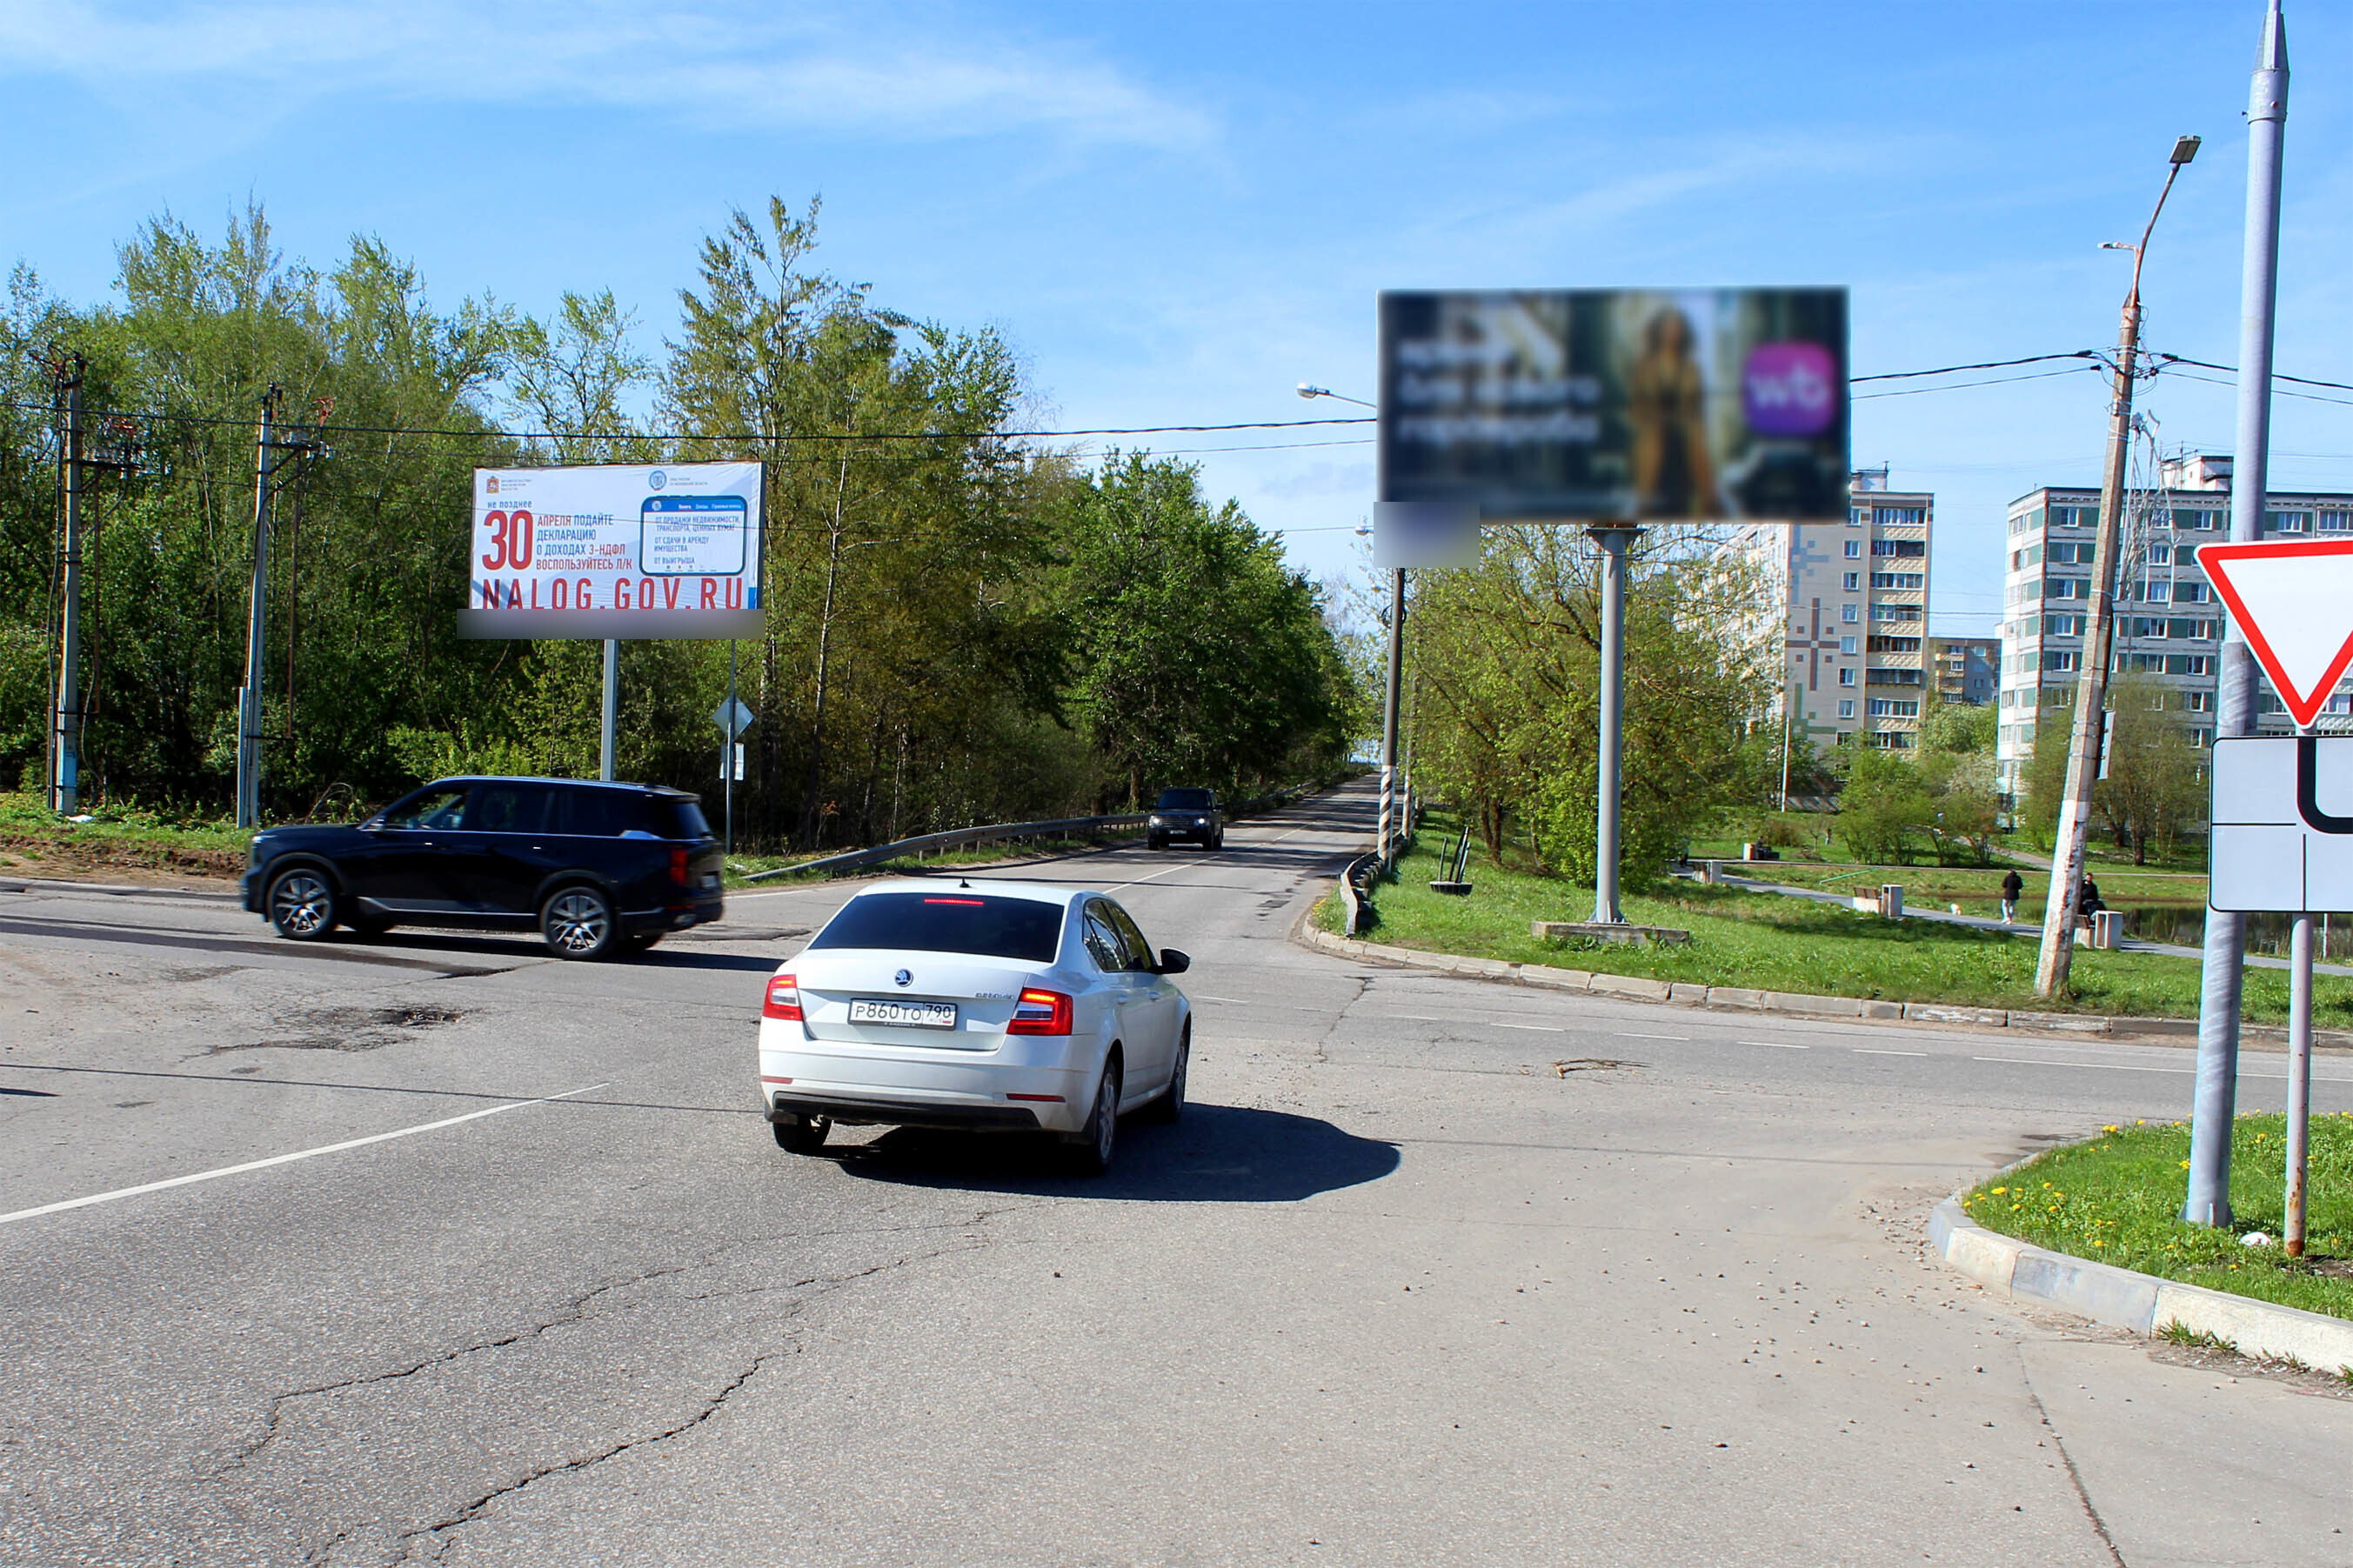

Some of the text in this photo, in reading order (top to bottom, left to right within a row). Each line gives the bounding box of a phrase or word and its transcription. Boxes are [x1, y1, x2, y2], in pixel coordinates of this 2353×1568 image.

[499, 500, 532, 509] позднее
[537, 513, 614, 527] АПРЕЛЯ ПОДАЙТЕ
[482, 510, 533, 570] 30
[536, 529, 596, 542] ДЕКЛАРАЦИЮ
[663, 537, 681, 545] СДАЧИ
[687, 536, 710, 544] АРЕНДУ
[536, 544, 625, 557] О ДОХОДАХ 3-НДФЛ
[536, 557, 632, 570] ВОСПОЛЬЗУЙТЕСЬ Л/К
[482, 577, 743, 609] NALOG.GOV.RU
[926, 1004, 952, 1018] 790
